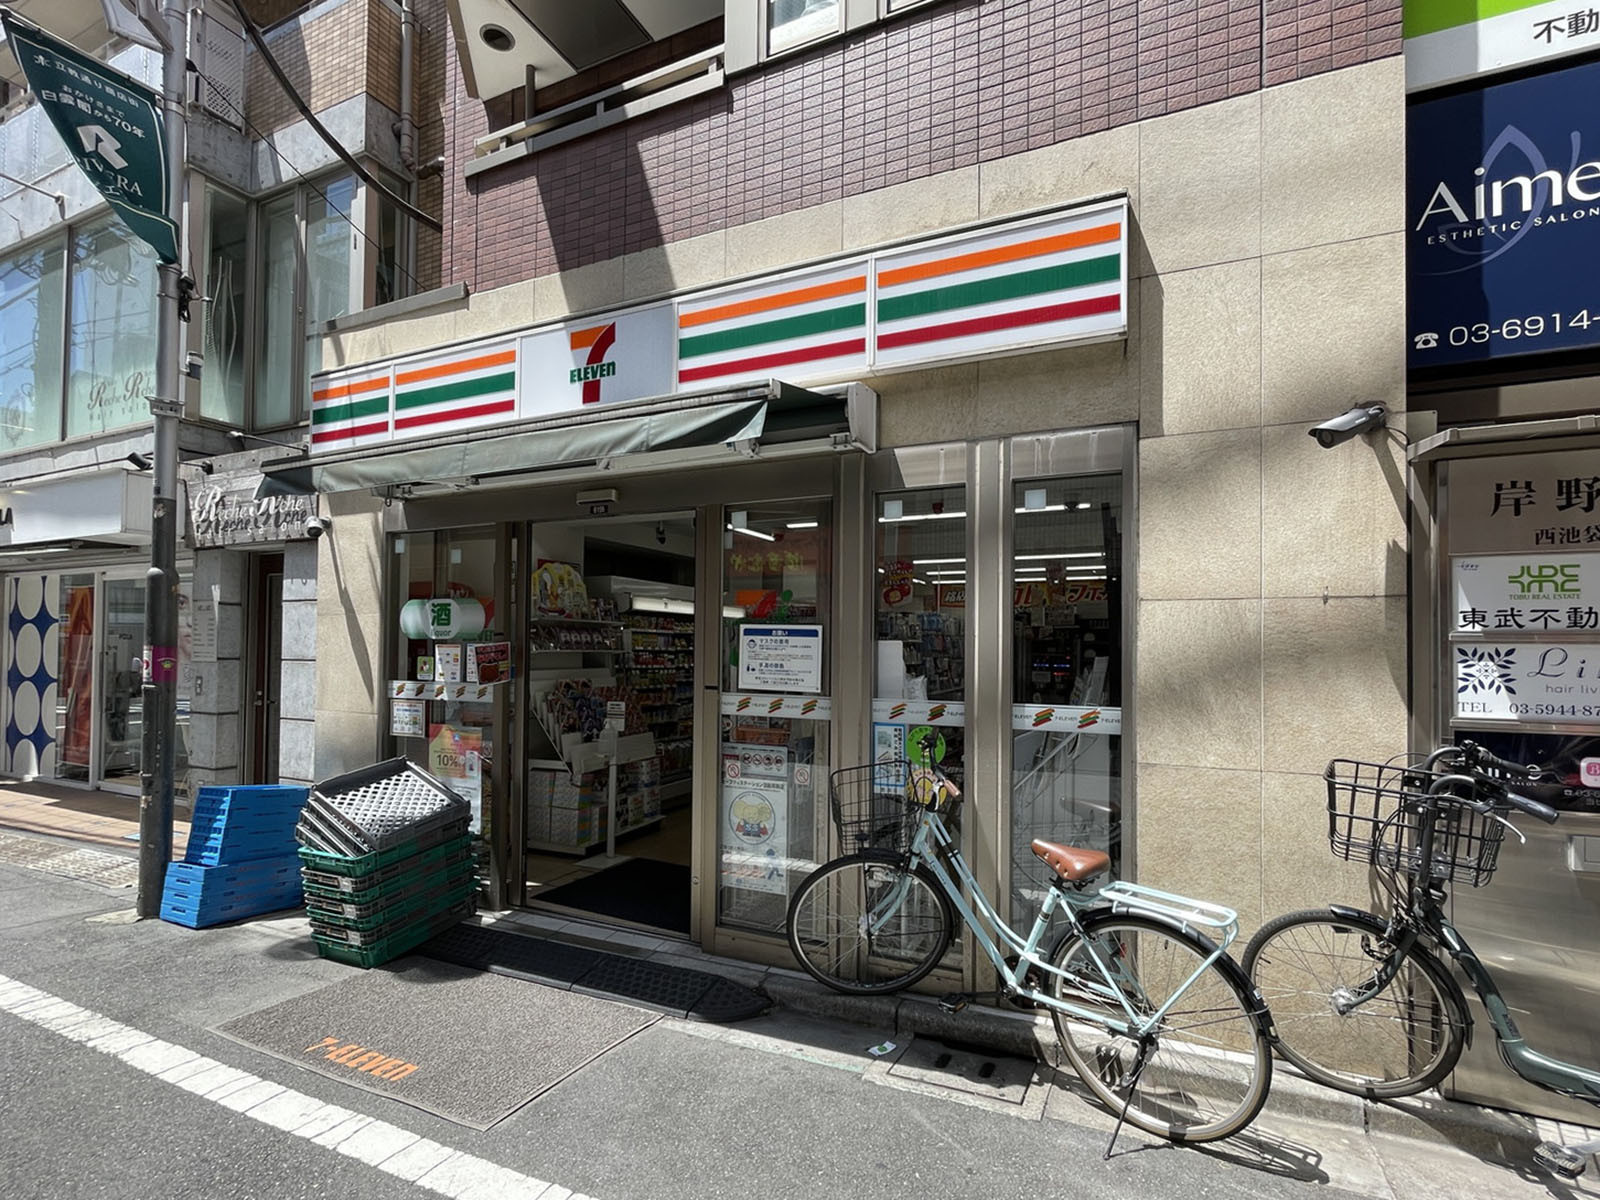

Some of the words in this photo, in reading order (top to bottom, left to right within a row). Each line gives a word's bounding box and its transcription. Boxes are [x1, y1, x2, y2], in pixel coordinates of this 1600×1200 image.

[1533, 8, 1600, 44] 不動
[1427, 221, 1521, 245] ESTHETIC
[1534, 207, 1600, 227] SALON
[1490, 477, 1600, 517] 岸野
[431, 602, 451, 626] 酒
[1459, 606, 1600, 630] 東武不動
[1527, 646, 1600, 679] Li
[1545, 684, 1574, 694] hair
[1458, 701, 1493, 713] TEL
